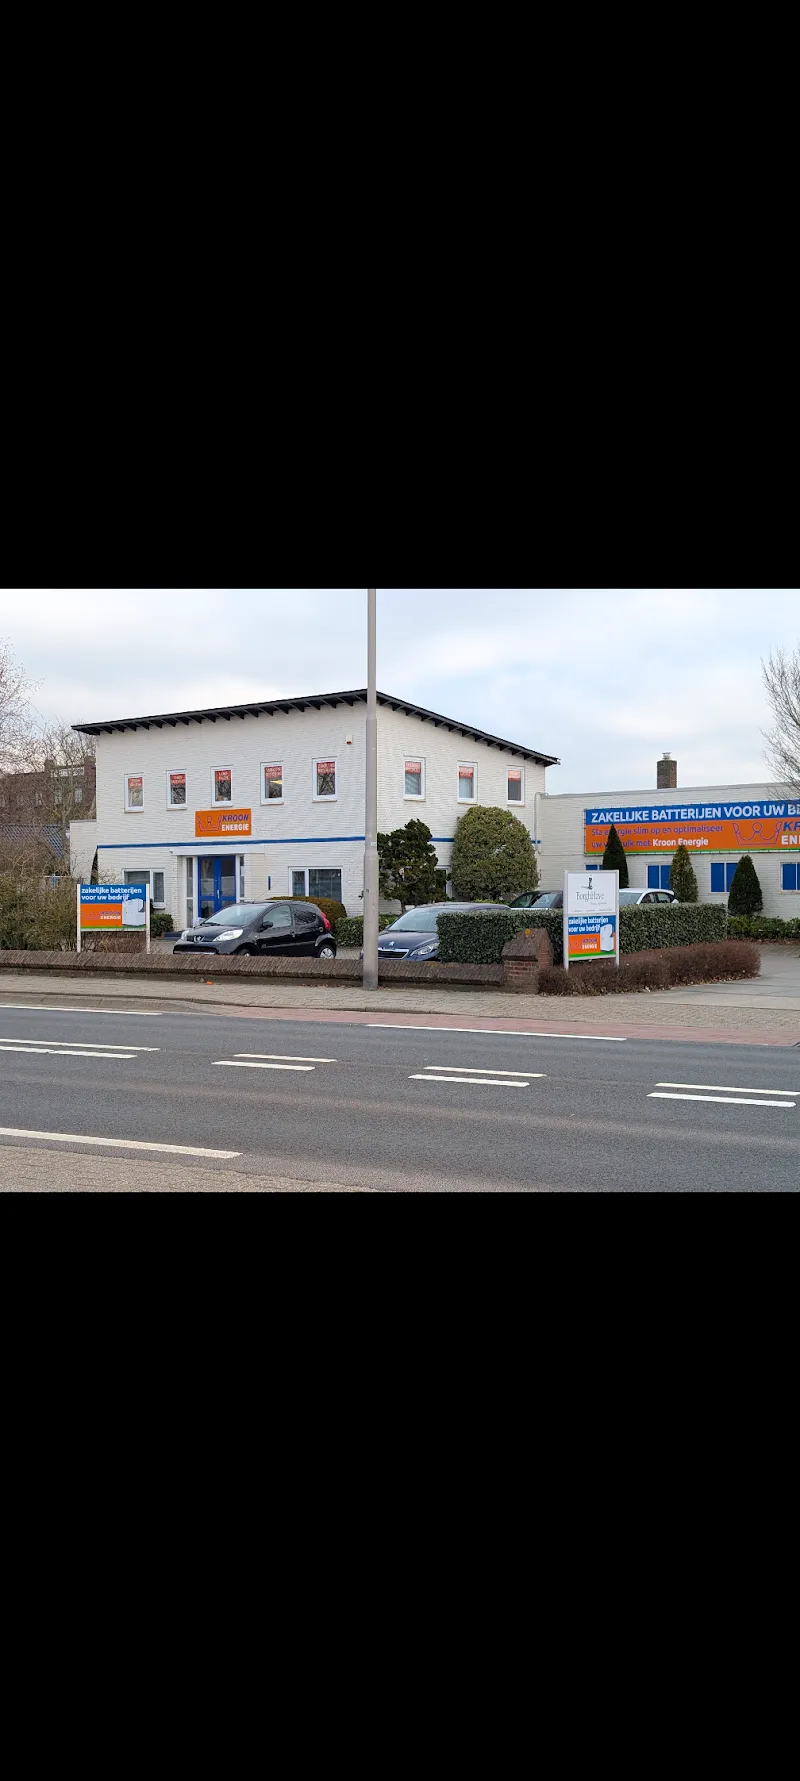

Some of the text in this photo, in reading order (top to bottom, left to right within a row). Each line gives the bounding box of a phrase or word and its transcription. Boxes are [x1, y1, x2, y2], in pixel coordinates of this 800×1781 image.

[222, 814, 248, 822] KROON
[592, 811, 649, 823] ZAKELIJKE
[652, 808, 721, 820] BATTERIJEN
[723, 805, 761, 818] VOOR
[764, 804, 785, 816] UW
[221, 823, 249, 831] ENERGIE
[591, 828, 602, 836] Sla
[604, 827, 632, 836] ergie
[633, 826, 649, 834] slim
[650, 827, 660, 835] op
[673, 824, 724, 834] optimaliseer
[652, 838, 677, 847] Kroon
[677, 837, 709, 848] Energie
[781, 834, 800, 845] EN
[110, 887, 142, 895] batterijen
[107, 894, 130, 902] bedrijf
[568, 916, 609, 926] zakelijke batterijen
